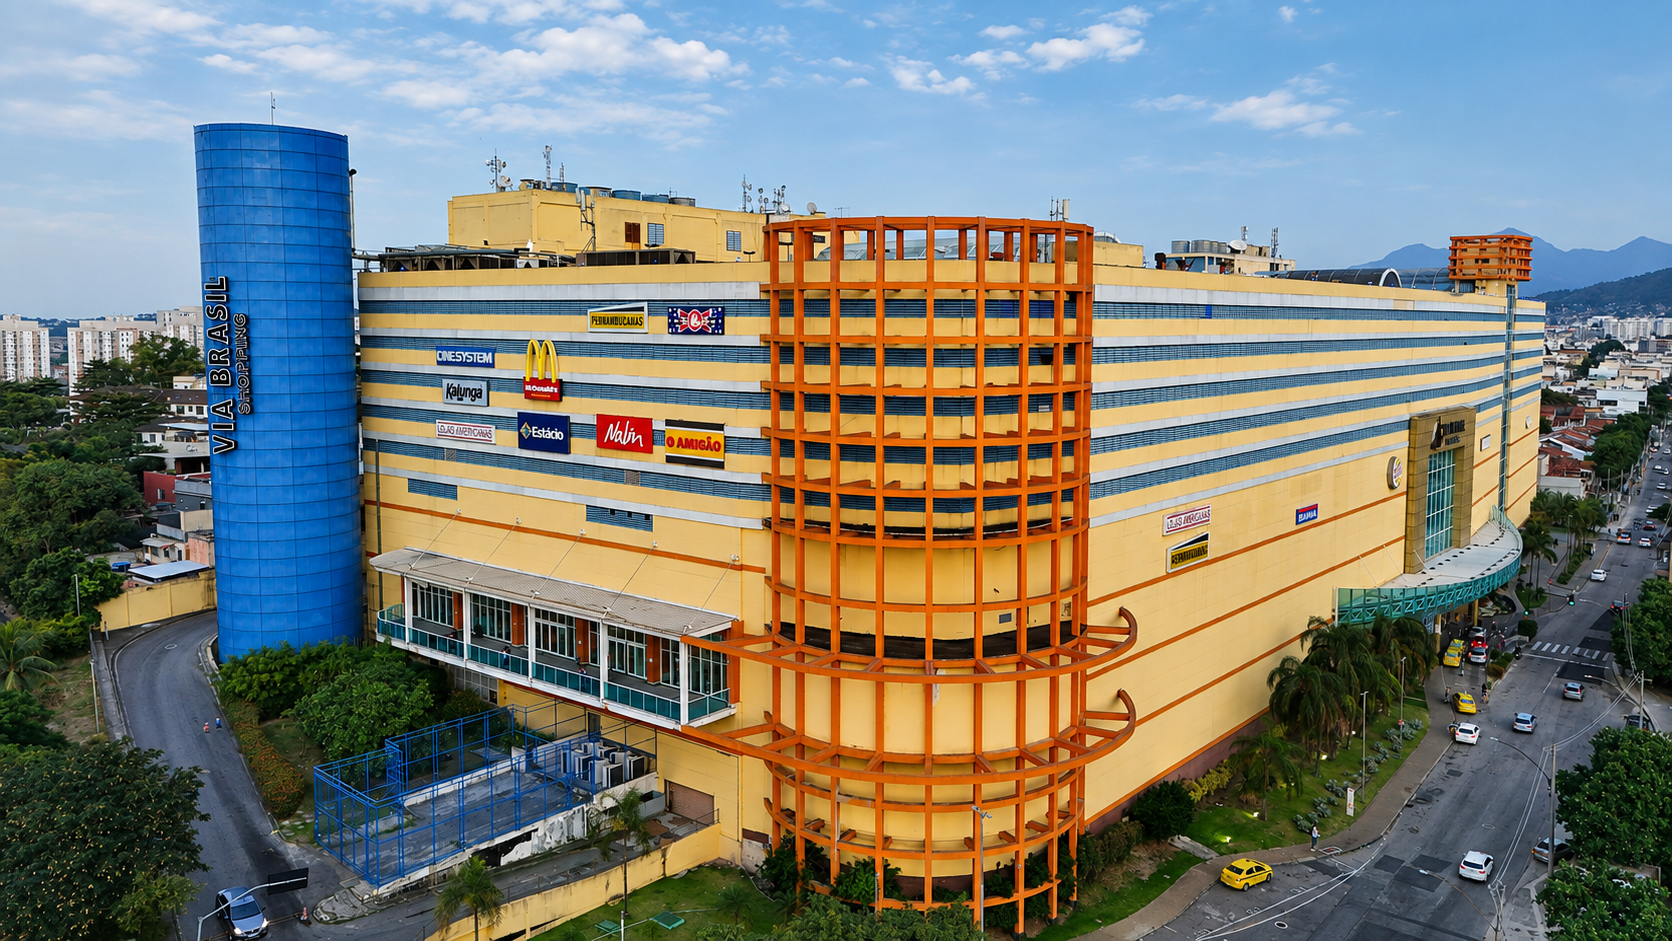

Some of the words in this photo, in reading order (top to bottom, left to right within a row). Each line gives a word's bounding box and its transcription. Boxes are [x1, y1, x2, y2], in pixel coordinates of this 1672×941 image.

[204, 276, 232, 387] BRASIL
[234, 313, 252, 415] SHOPPING
[436, 350, 493, 364] CINESYSTEM
[445, 383, 483, 402] Kalunga
[211, 398, 237, 454] VIA
[532, 426, 564, 441] Estácio
[604, 420, 644, 448] Nalin
[666, 436, 675, 448] O
[676, 436, 721, 452] AMIGÃO
